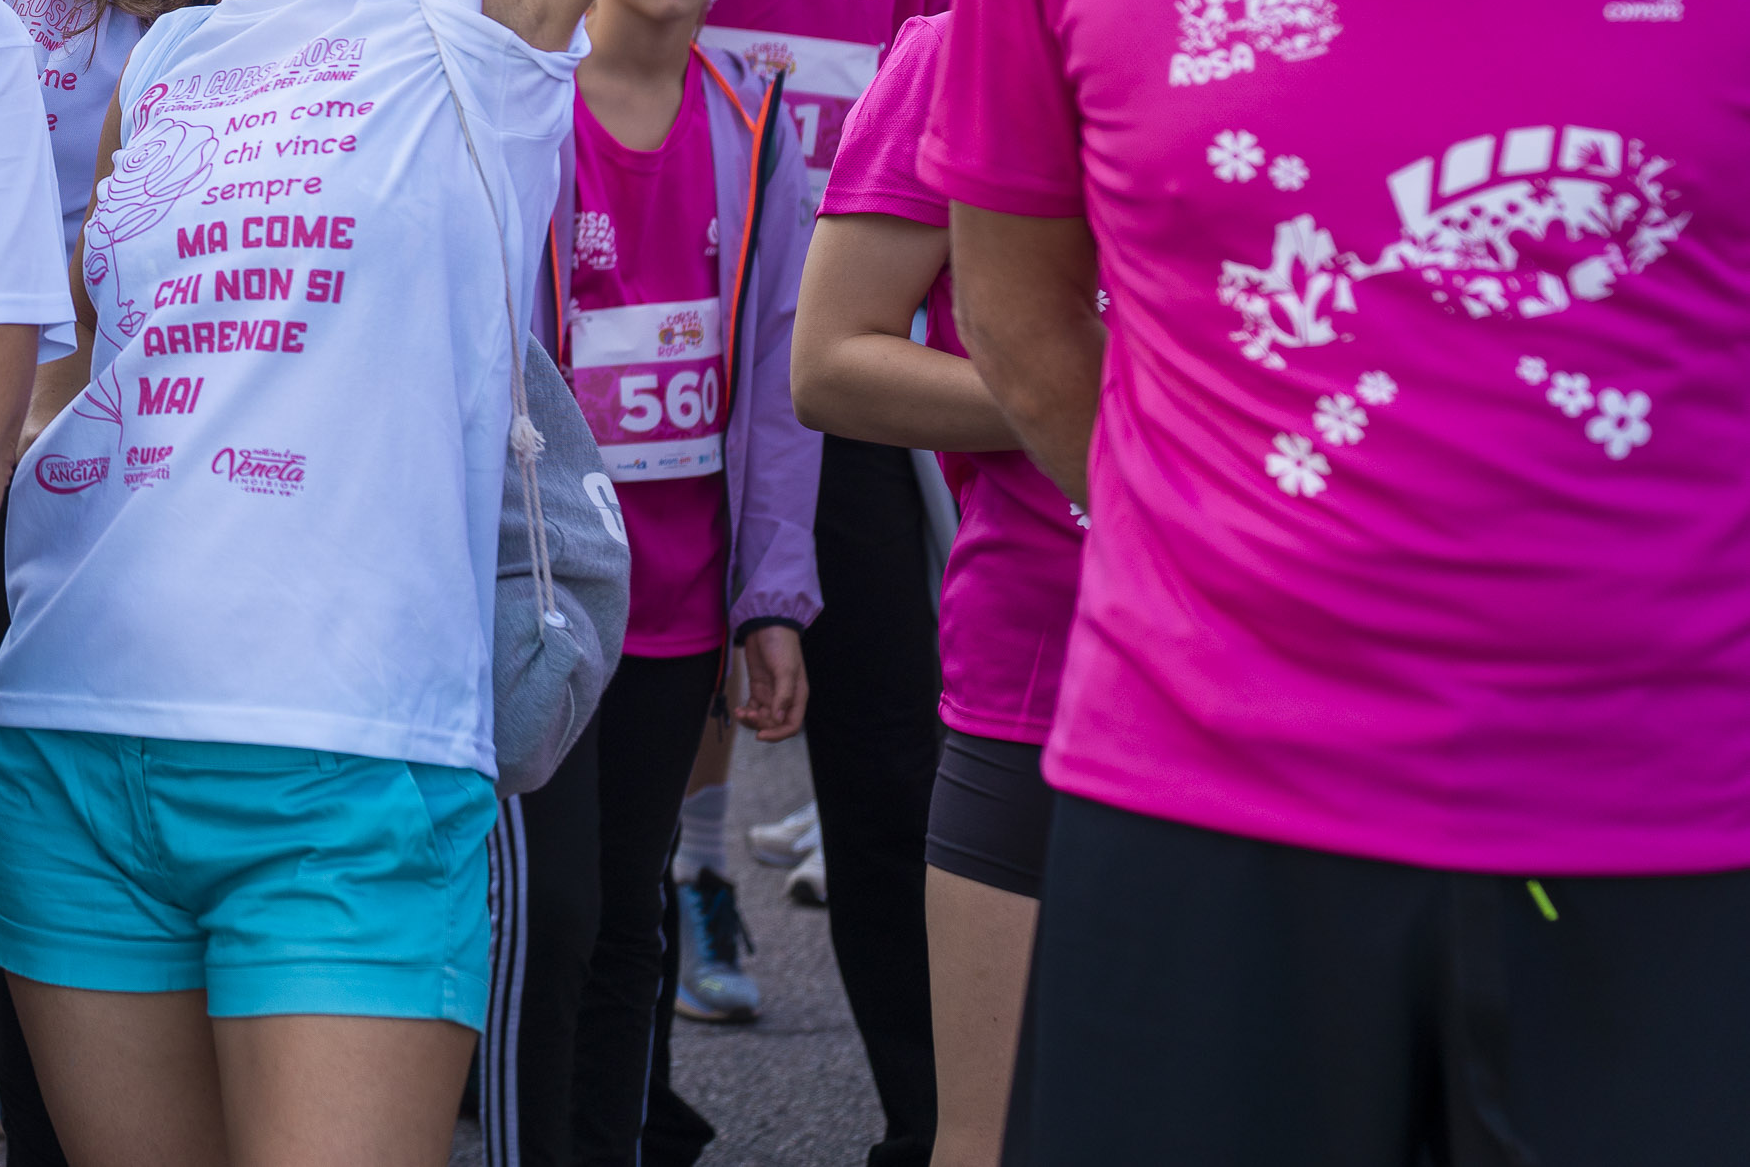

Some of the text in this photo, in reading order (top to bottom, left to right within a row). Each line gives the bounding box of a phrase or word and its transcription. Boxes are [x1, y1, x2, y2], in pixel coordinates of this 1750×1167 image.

[38, 68, 77, 91] me
[272, 77, 296, 91] PER
[313, 70, 358, 82] DONNE
[1169, 42, 1255, 87] ROSA
[168, 75, 201, 101] LA
[225, 100, 374, 136] Non come
[224, 132, 357, 166] chi vince
[201, 174, 322, 205] sempre
[176, 215, 356, 259] MA COME
[154, 267, 345, 310] CHI NON SI
[143, 320, 308, 357] ARRENDE
[137, 376, 205, 417] MAI
[619, 366, 719, 432] 560
[46, 460, 75, 470] CENTRO
[211, 447, 305, 482] Veneta
